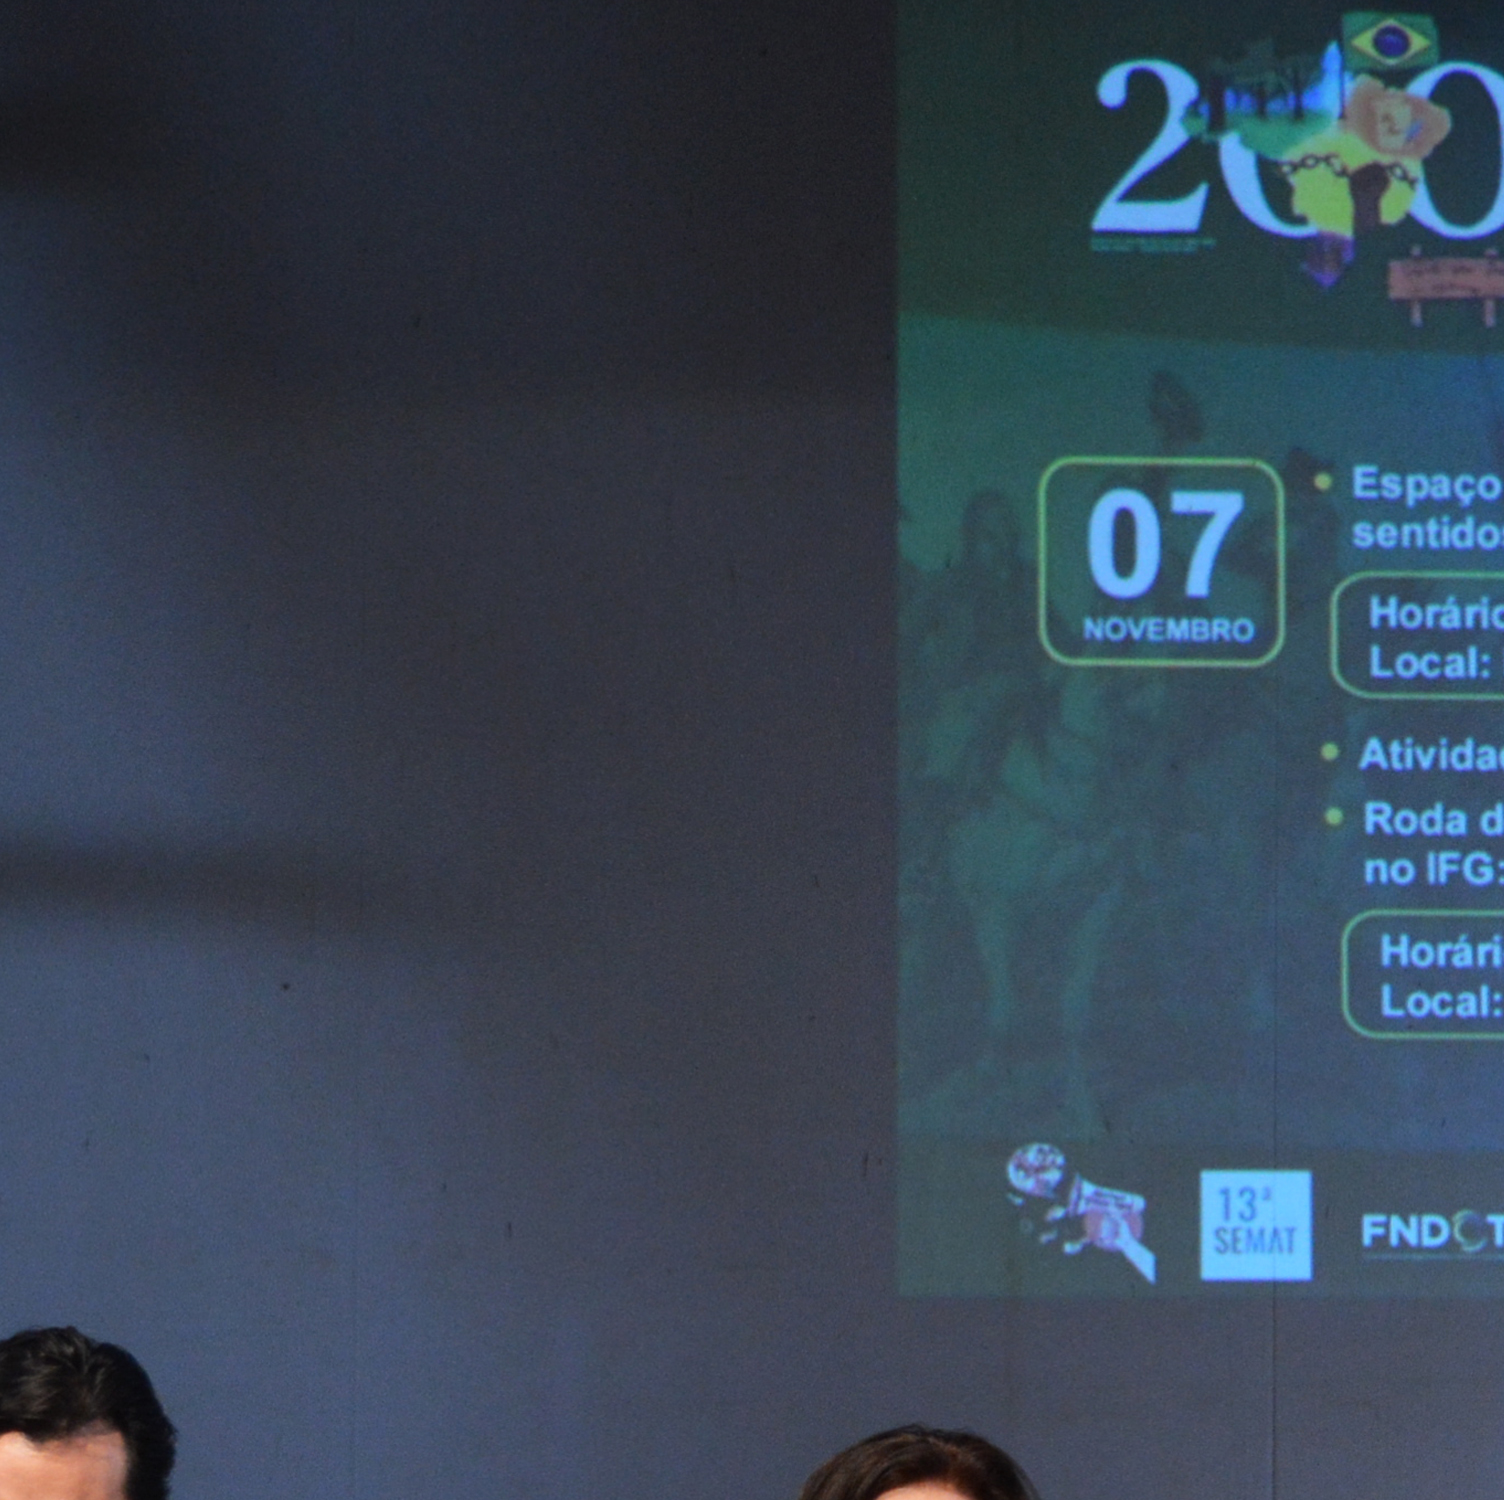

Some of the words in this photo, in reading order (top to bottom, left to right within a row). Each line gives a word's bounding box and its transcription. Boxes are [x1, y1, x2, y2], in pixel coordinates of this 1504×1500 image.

[1352, 464, 1502, 508] Espaço
[1088, 488, 1244, 600] 07
[1084, 618, 1254, 642] NOVEMBRO
[1370, 645, 1491, 679] Local:
[1364, 802, 1468, 836] Roda
[1365, 857, 1414, 885] no
[1381, 984, 1502, 1019] Local:
[1213, 1226, 1297, 1255] SEMAT
